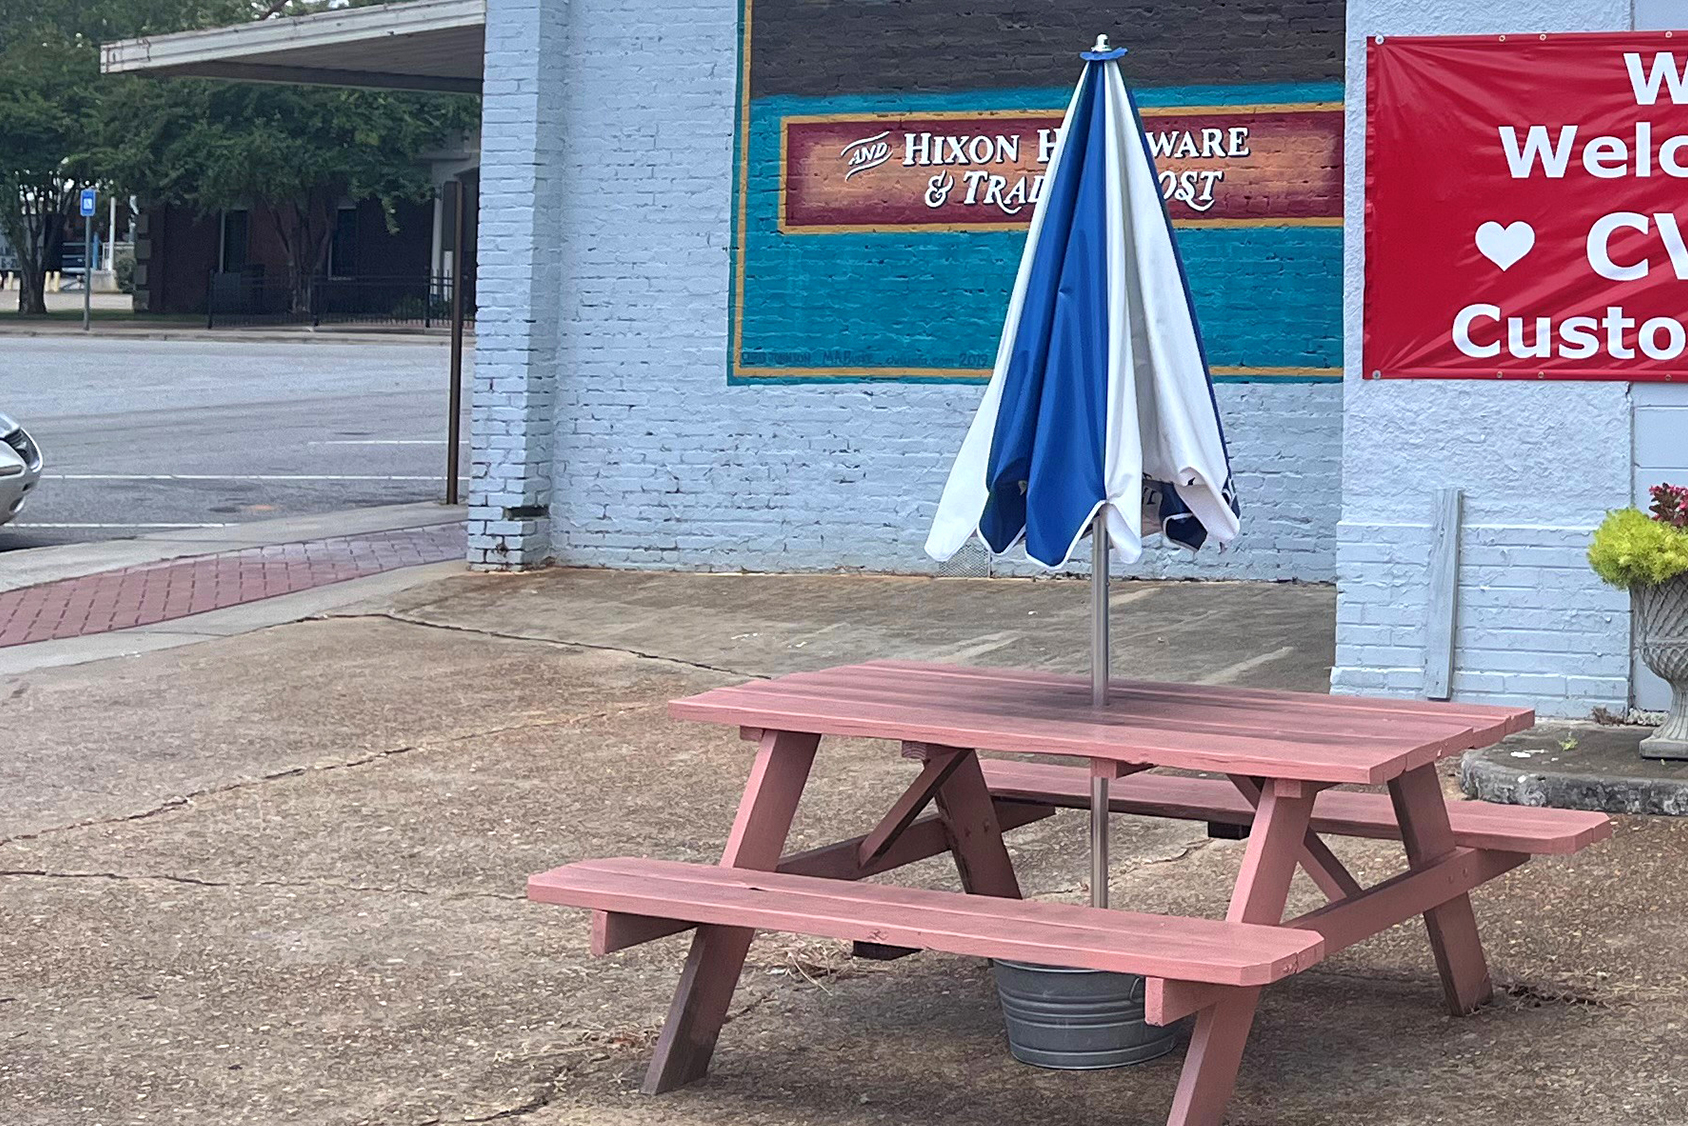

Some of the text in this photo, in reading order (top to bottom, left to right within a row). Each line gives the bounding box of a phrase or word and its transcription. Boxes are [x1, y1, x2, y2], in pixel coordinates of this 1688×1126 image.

[848, 127, 1250, 166] AND HIXON HWARE
[924, 170, 954, 209] &
[1157, 170, 1224, 211] OST
